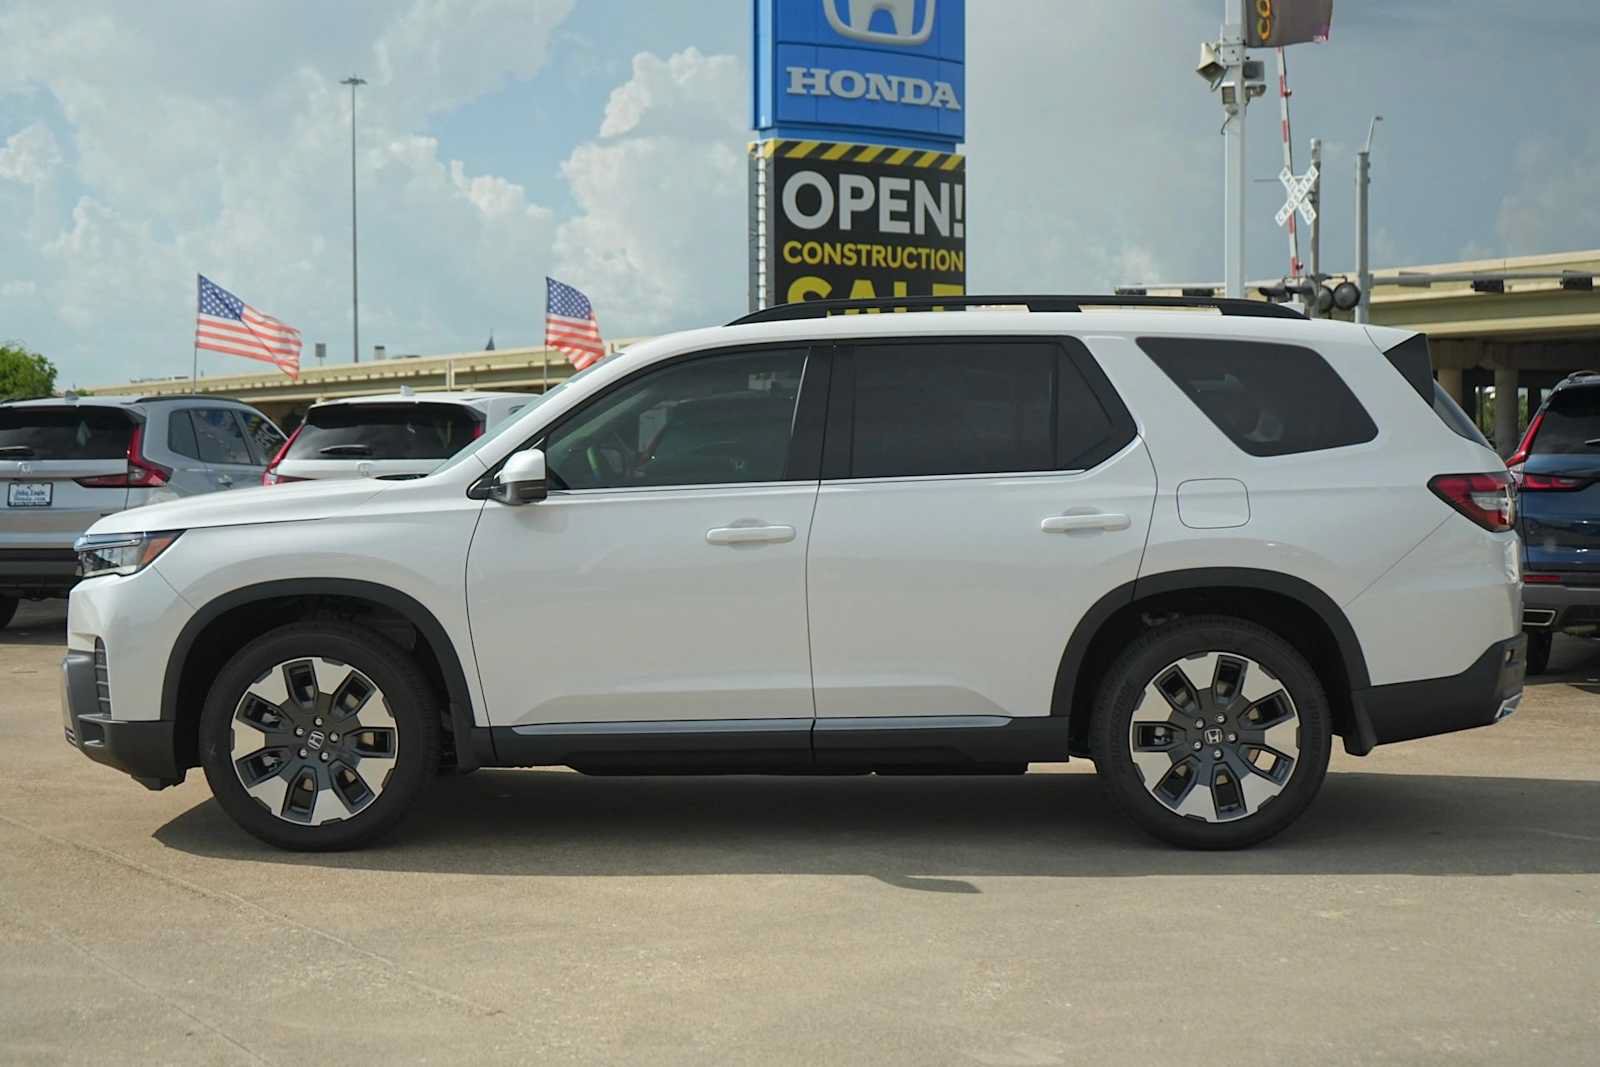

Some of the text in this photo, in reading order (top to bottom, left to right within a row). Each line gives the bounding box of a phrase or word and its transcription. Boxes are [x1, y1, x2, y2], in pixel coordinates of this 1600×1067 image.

[786, 66, 961, 110] HONDA
[782, 170, 964, 238] OPEN!
[783, 241, 964, 272] CONSTRUCTION
